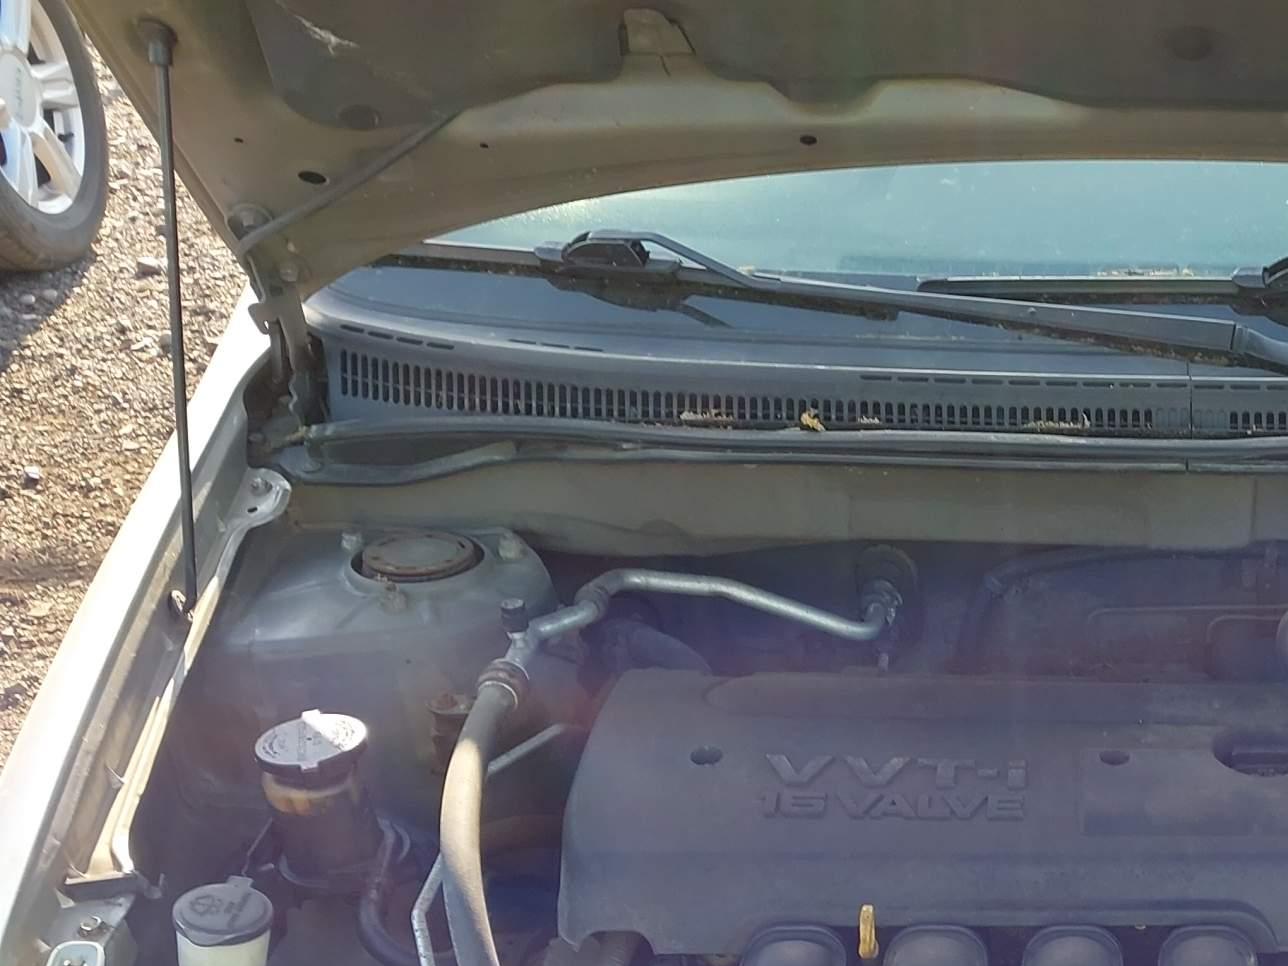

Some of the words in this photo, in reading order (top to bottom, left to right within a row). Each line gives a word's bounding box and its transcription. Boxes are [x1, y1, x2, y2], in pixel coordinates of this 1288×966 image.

[764, 752, 1028, 790] VVT-i
[760, 791, 828, 819] 16
[836, 792, 1027, 821] VALVE
